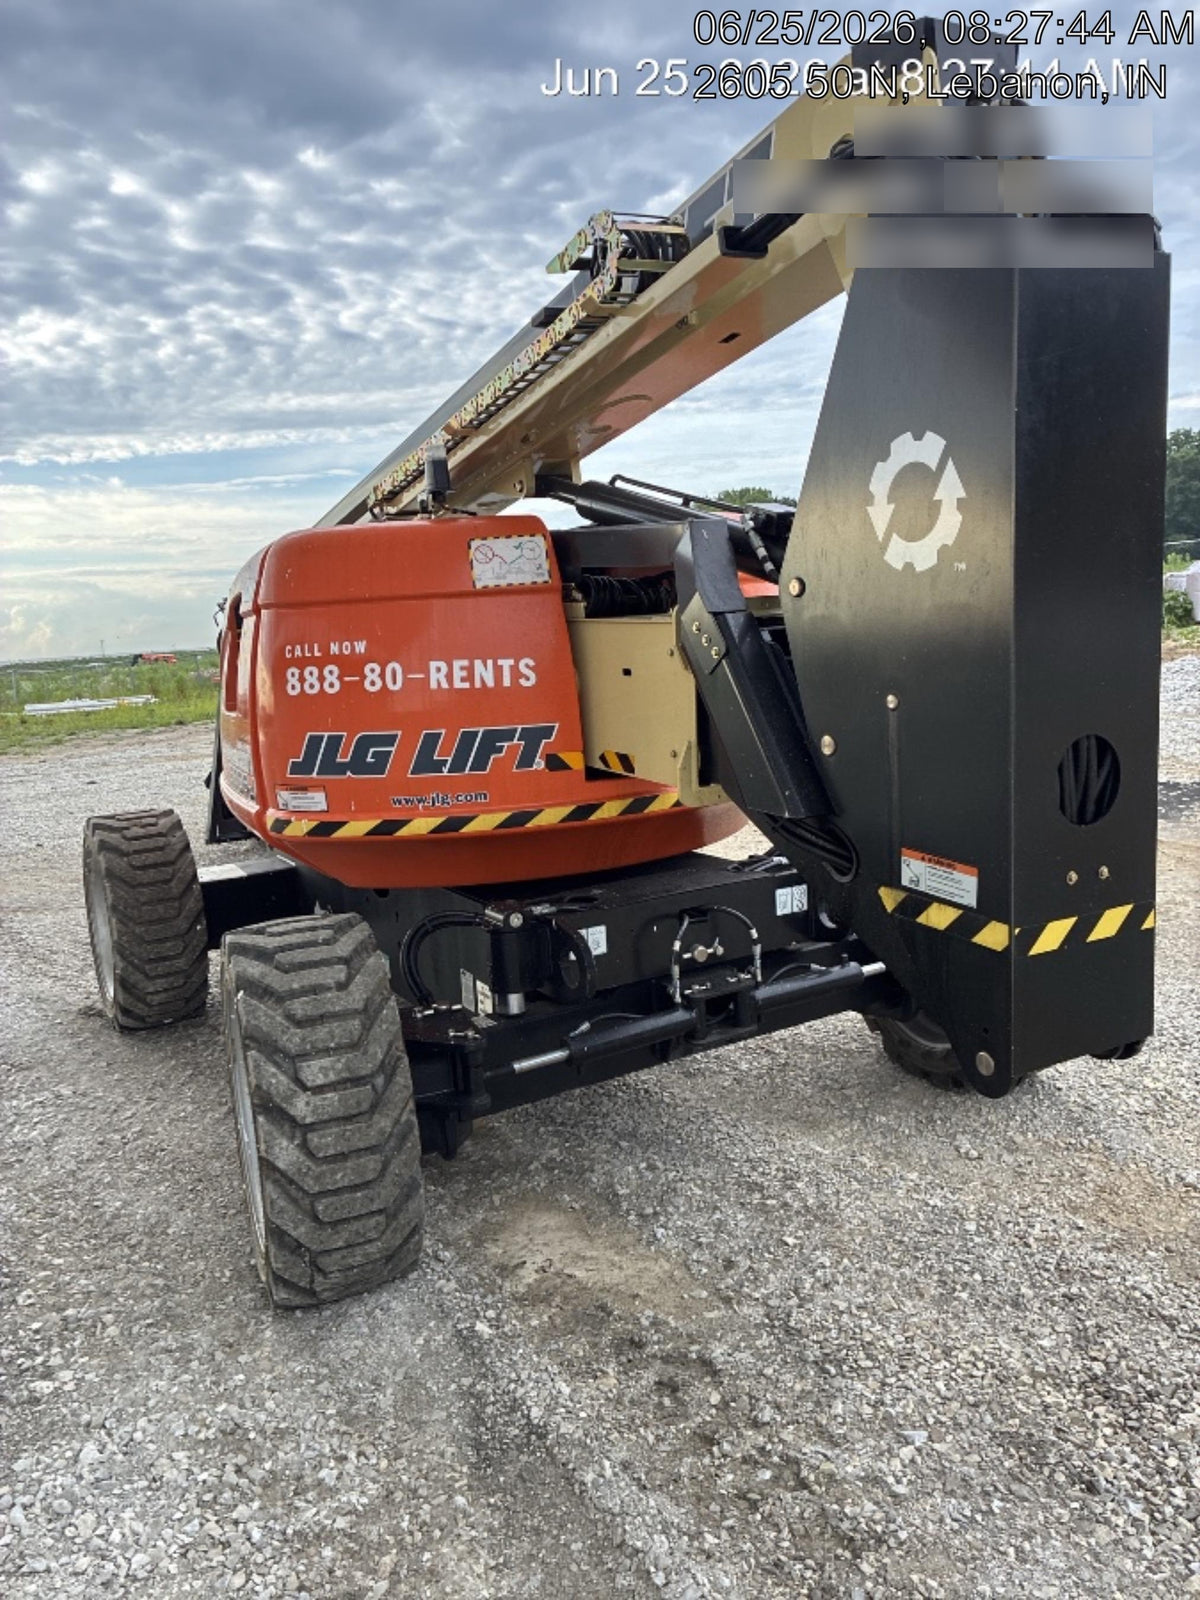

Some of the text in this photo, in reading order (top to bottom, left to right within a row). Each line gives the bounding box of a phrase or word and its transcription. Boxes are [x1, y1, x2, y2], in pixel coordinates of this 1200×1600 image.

[285, 640, 368, 659] CALL NOW
[285, 657, 537, 696] 888-80-RENTS
[286, 723, 560, 778] JLG LIFT
[391, 790, 489, 808] www.jlg.com
